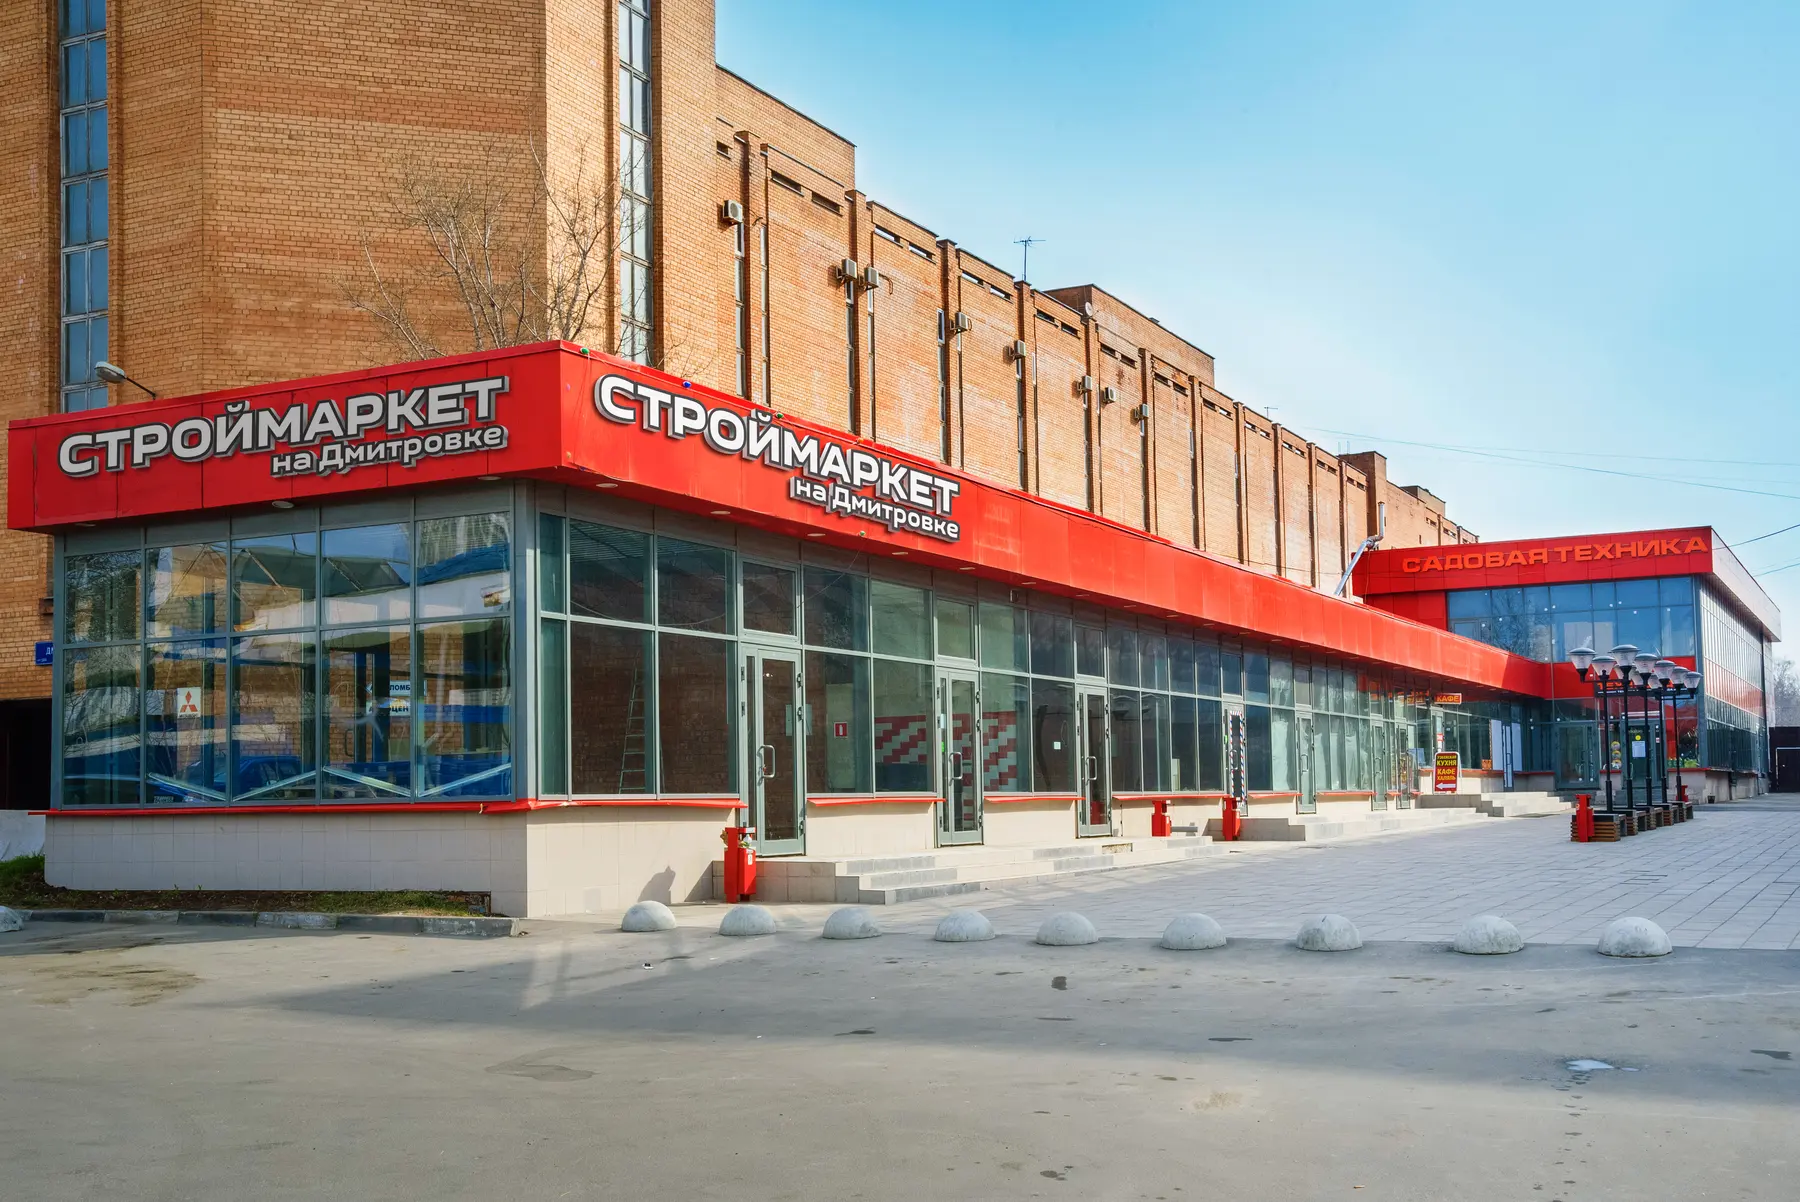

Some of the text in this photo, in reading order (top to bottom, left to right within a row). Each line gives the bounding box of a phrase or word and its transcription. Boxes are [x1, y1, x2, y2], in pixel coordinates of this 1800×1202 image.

[58, 376, 509, 476] СТРОЙМАРКЕТ
[271, 425, 509, 477] на Дмитровке
[595, 373, 960, 514] СТРОЙМАРКЕТ
[790, 476, 960, 542] на Дмитровке
[1402, 537, 1708, 573] САДОВАЯ ТЕХНИКА
